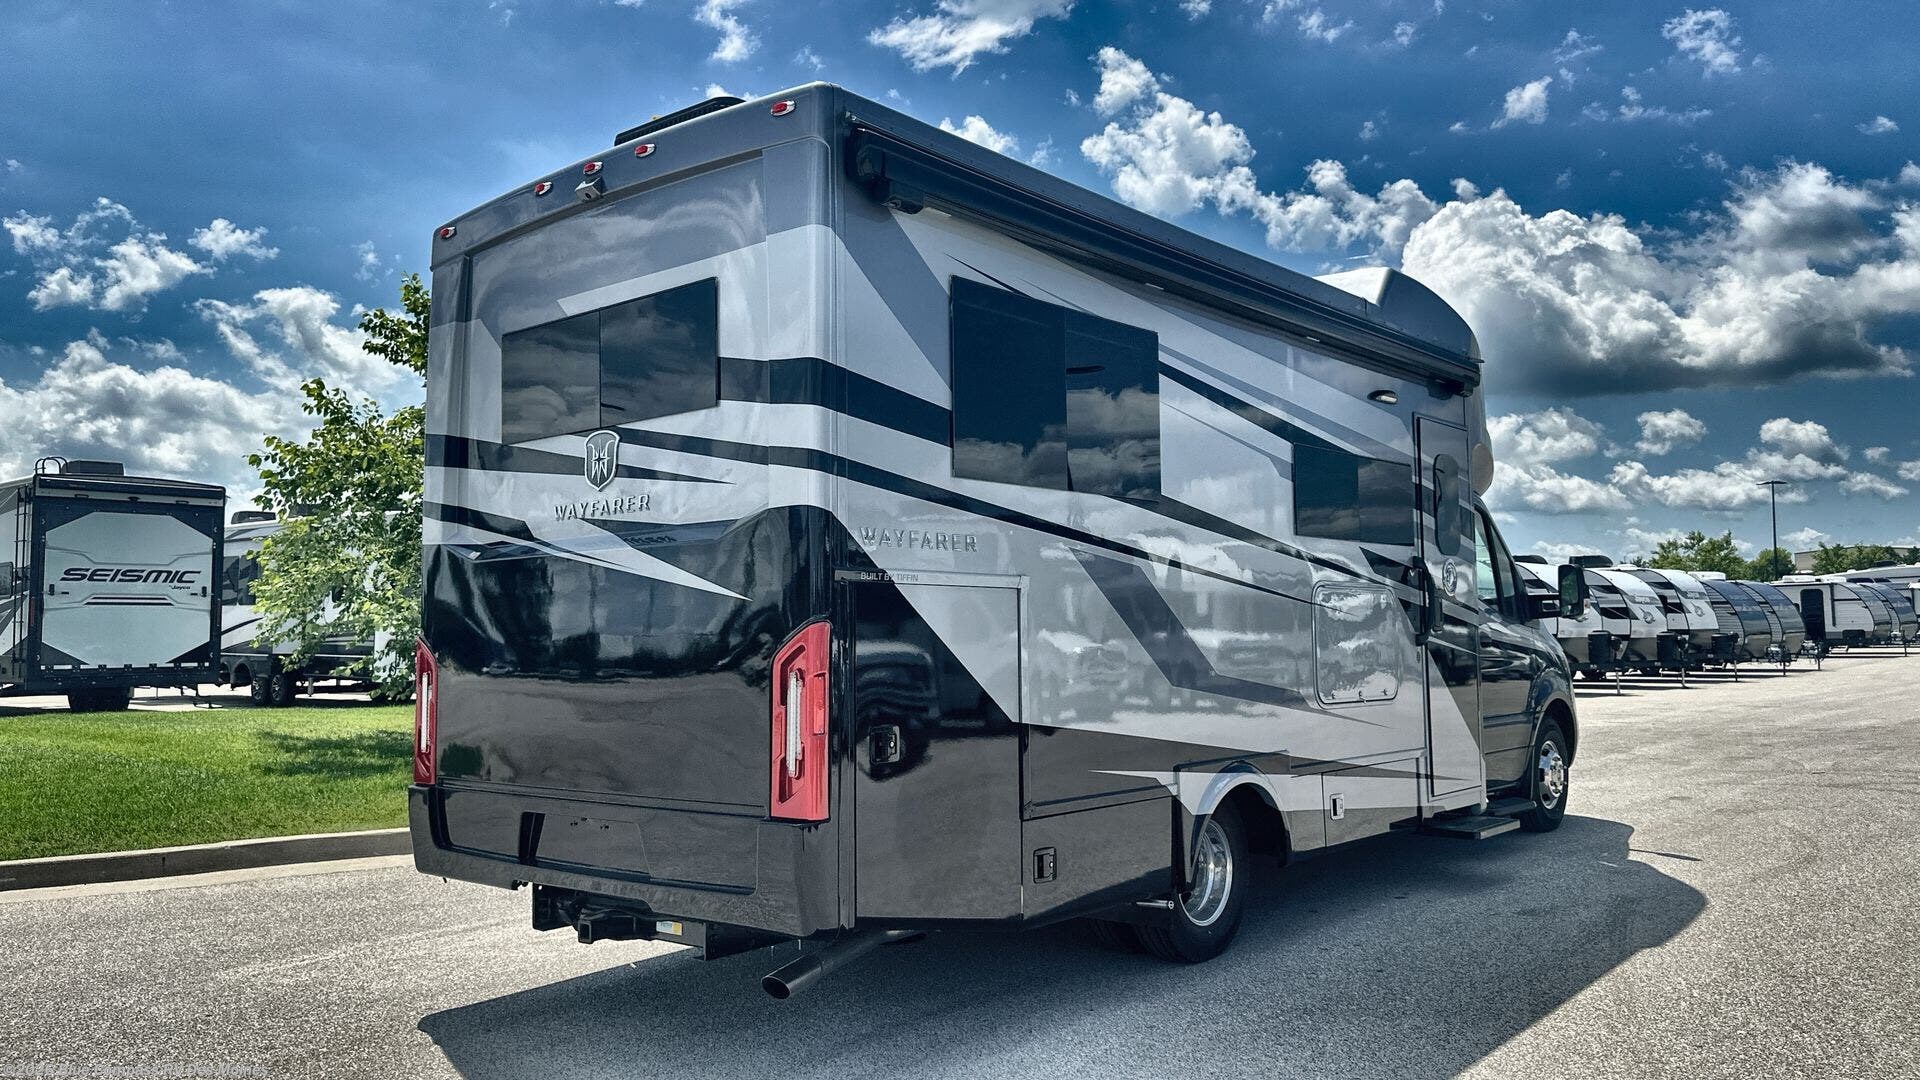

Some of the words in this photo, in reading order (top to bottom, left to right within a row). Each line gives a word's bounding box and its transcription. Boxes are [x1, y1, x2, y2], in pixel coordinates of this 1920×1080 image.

[553, 494, 651, 521] WAYFARER
[859, 527, 978, 553] WAYFARER
[60, 568, 201, 584] SEISMIC
[860, 571, 883, 581] BUILT
[896, 573, 919, 582] TIFFIN
